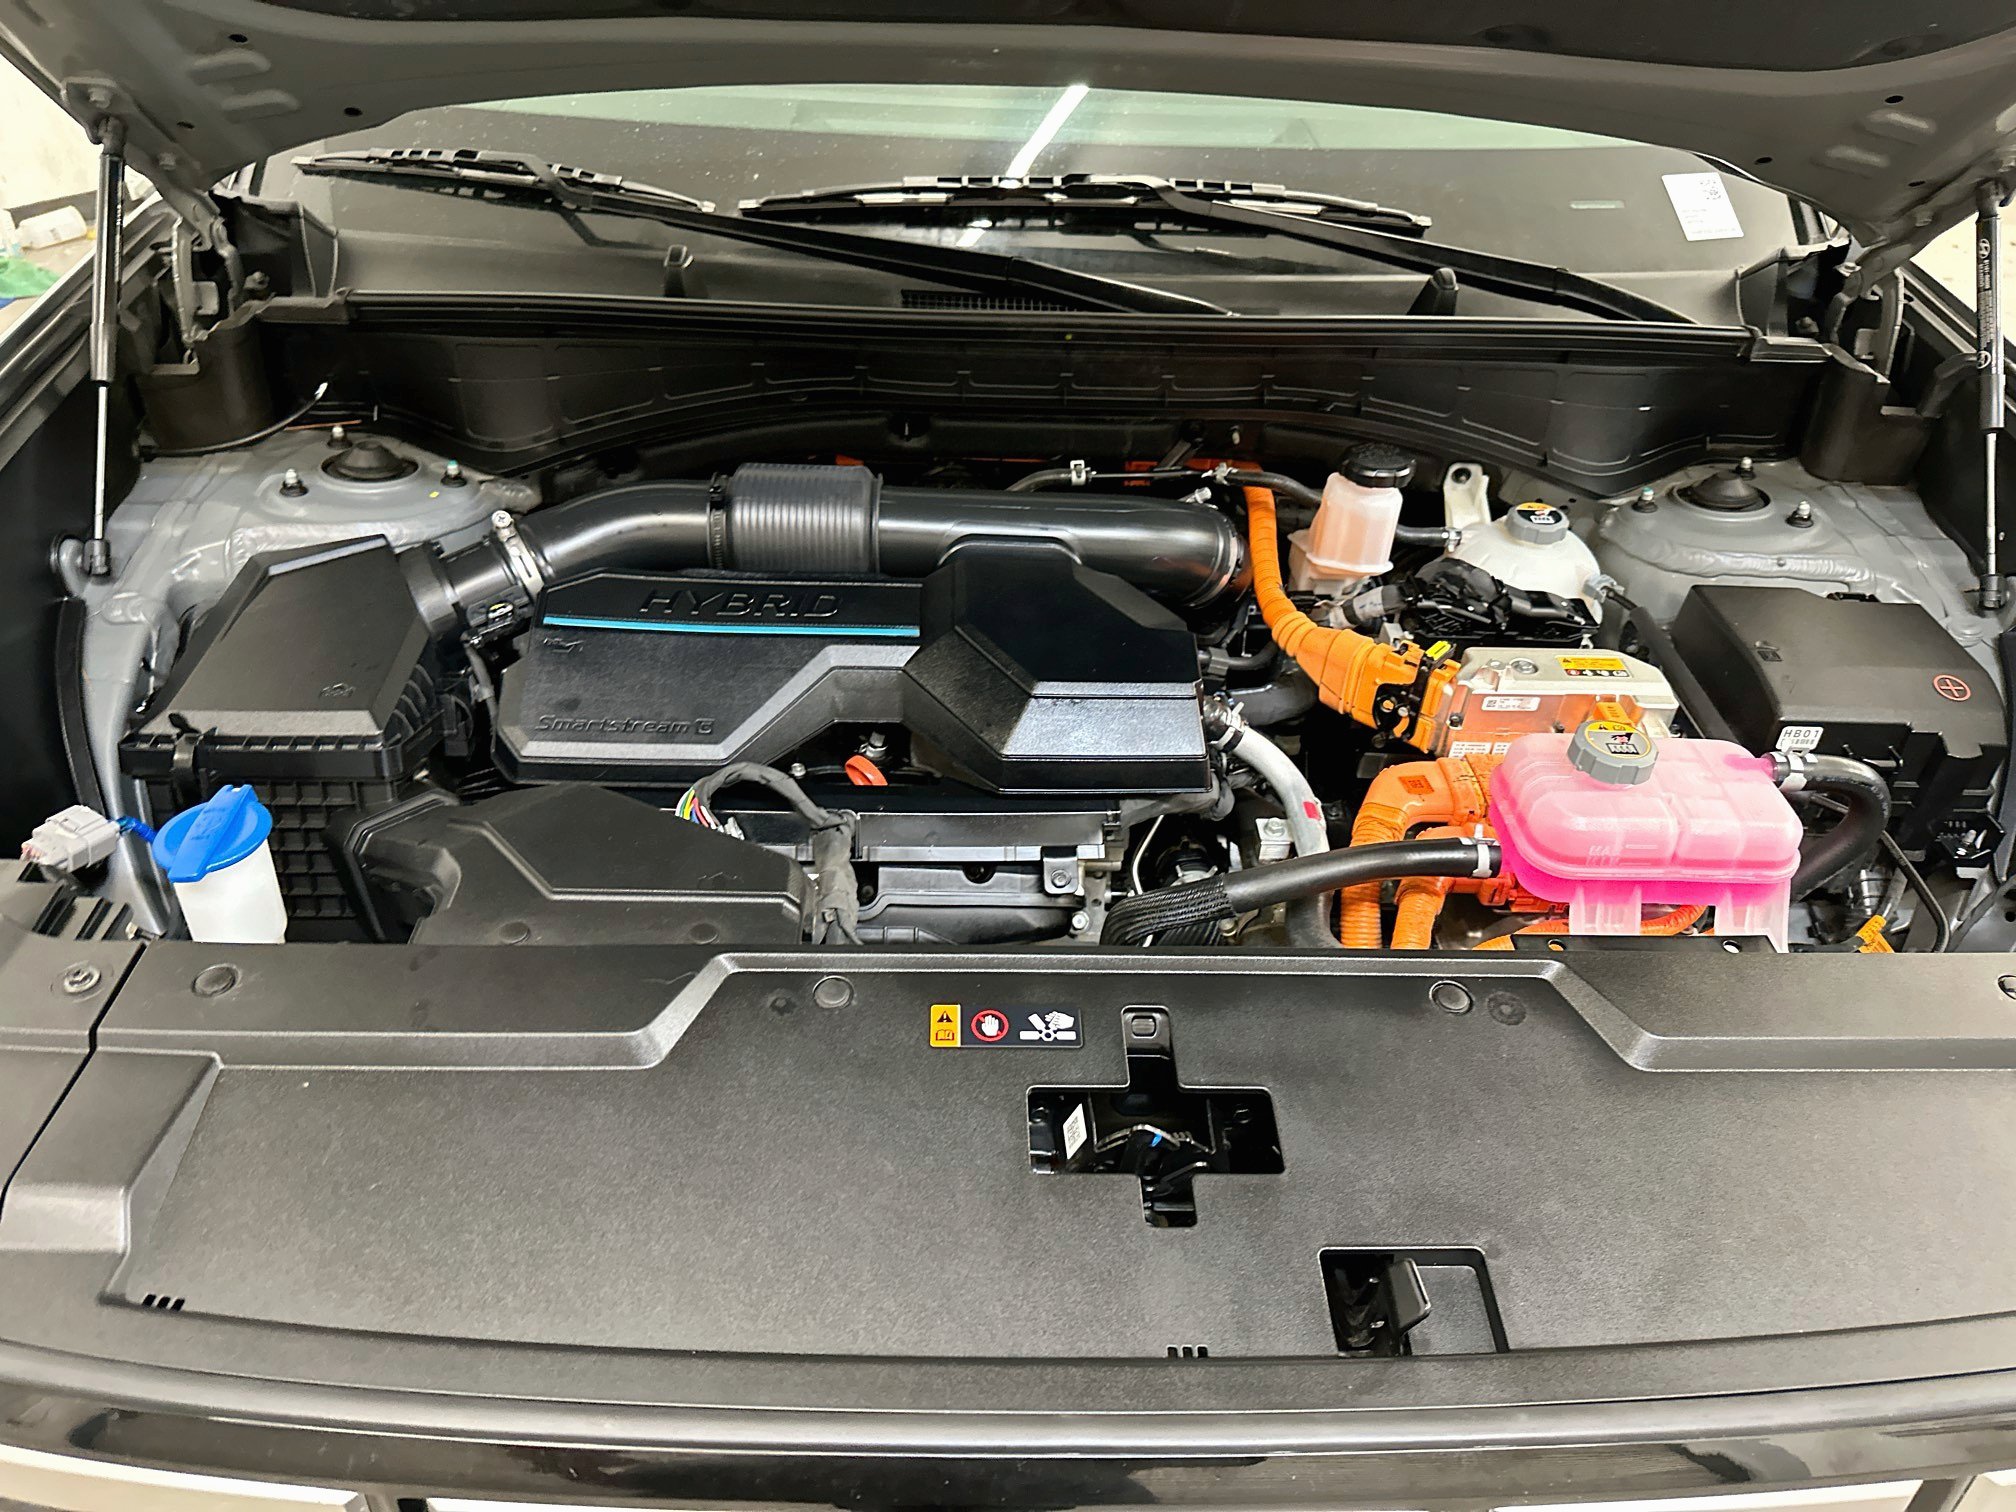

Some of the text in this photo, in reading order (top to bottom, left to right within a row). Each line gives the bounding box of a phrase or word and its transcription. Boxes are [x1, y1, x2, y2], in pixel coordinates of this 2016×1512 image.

[638, 588, 838, 617] HYBRID
[534, 714, 692, 733] Smartstream
[1783, 729, 1819, 738] HB01
